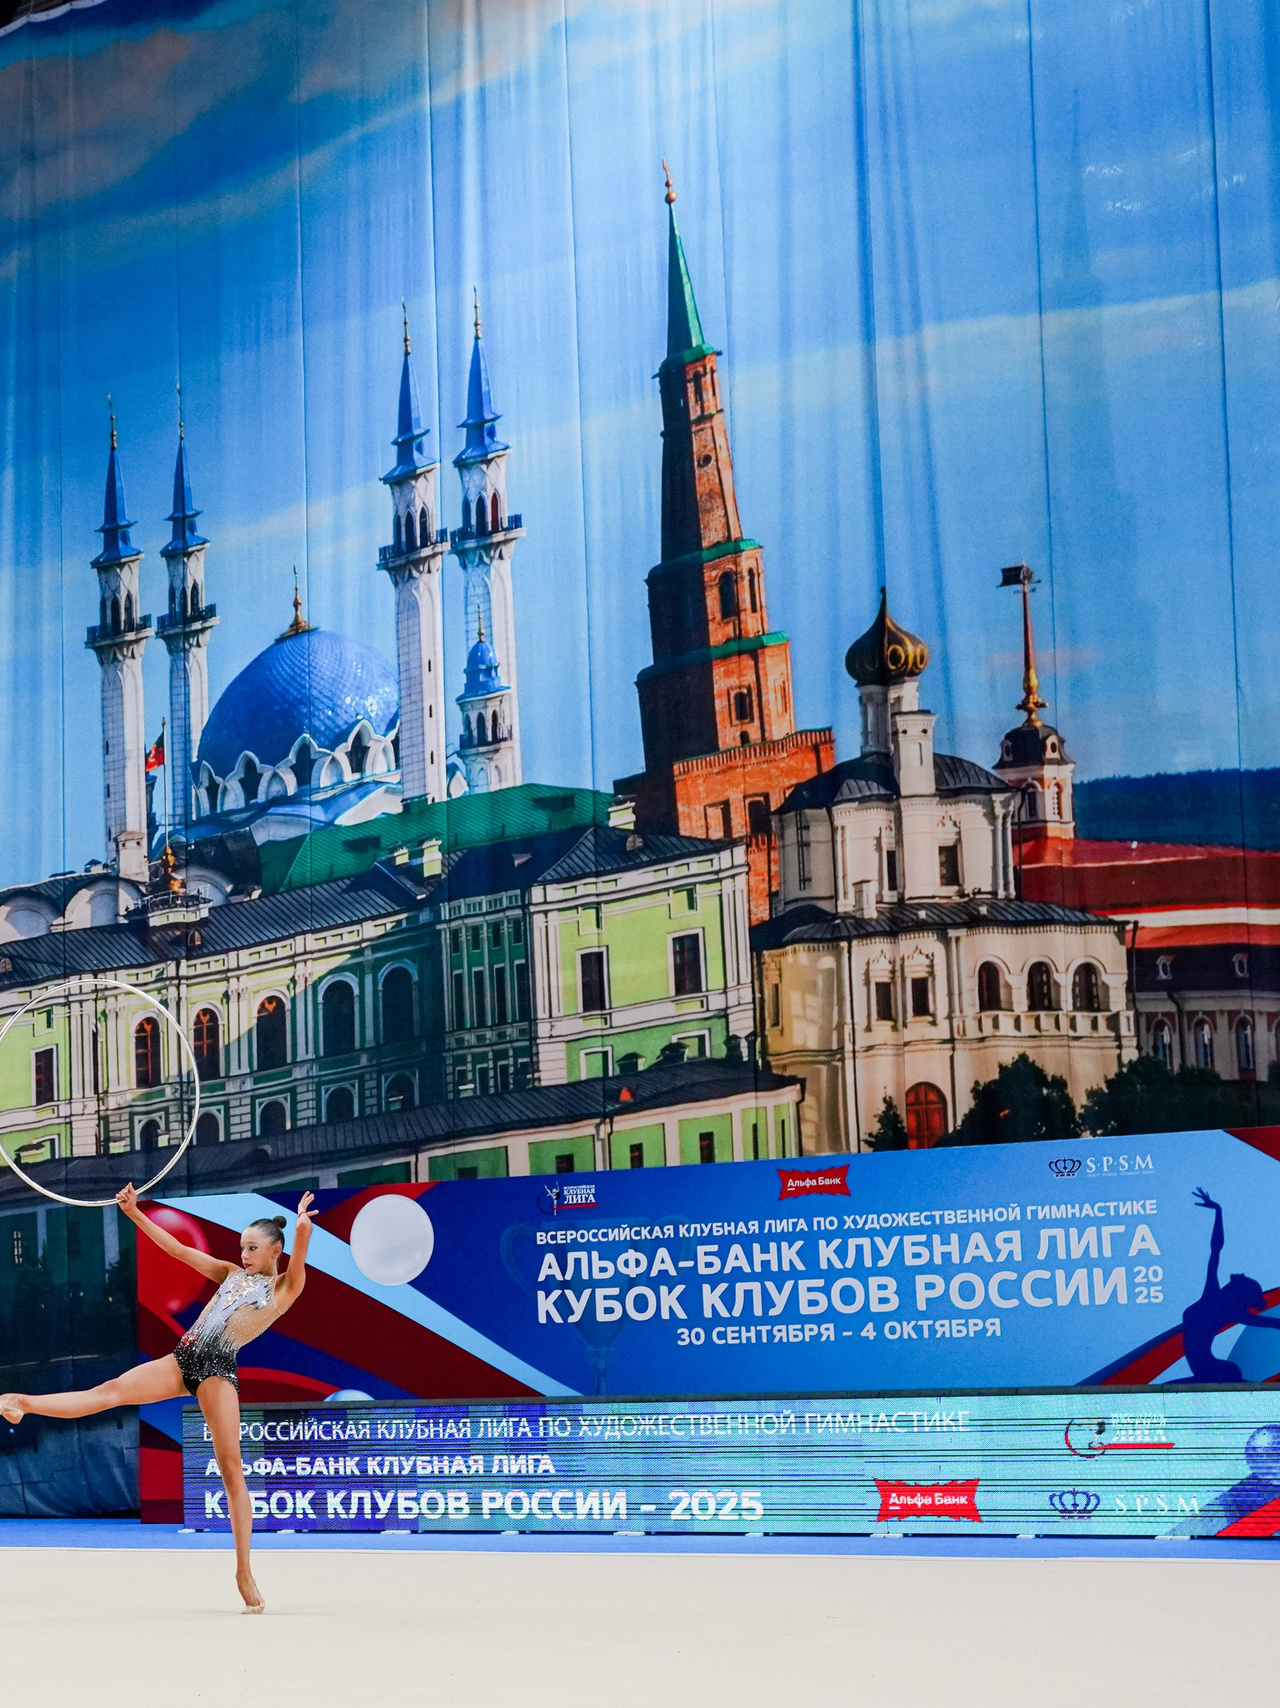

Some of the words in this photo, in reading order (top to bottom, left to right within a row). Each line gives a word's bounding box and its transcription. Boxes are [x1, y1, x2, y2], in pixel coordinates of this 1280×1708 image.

[563, 1188, 596, 1196] КЛУБНАЯ
[787, 1178, 817, 1190] Альфа
[818, 1176, 841, 1186] Банк
[563, 1193, 596, 1204] ЛИГА
[536, 1224, 674, 1245] ВСЕРОССИЙСКАЯ
[678, 1219, 759, 1238] КЛУБНАЯ
[763, 1217, 809, 1234] ЛИГА
[812, 1215, 839, 1231] ПО
[842, 1203, 1021, 1230] ХУДОЖЕСТВЕННОЙ
[1026, 1199, 1158, 1220] ГИМНАСТИКЕ
[537, 1242, 806, 1282] АЛЬФА-БАНК
[819, 1229, 1023, 1270] КЛУБНАЯ
[1036, 1224, 1161, 1261] ЛИГА
[1133, 1265, 1164, 1283] 20
[537, 1284, 688, 1324] КУБОК
[702, 1275, 900, 1319] КЛУБОВ
[915, 1266, 1128, 1312] РОССИИ
[1134, 1286, 1164, 1304] 25
[677, 1327, 706, 1346] 30
[711, 1323, 835, 1345] СЕНТЯБРЯ
[860, 1322, 877, 1340] 4
[883, 1317, 1001, 1340] ОКТЯБРЯ
[203, 1418, 370, 1441] ВРОССИЙСКАЯ
[377, 1419, 470, 1439] КЛУБНАЯ
[478, 1417, 532, 1438] ЛИГА
[539, 1416, 571, 1437] ПО
[578, 1409, 796, 1440] ХУДОЖЕСТВЕННОЙ
[805, 1411, 971, 1434] ГИМНАСТИКЕ
[205, 1457, 360, 1476] АЬФА-БАНК
[367, 1456, 484, 1476] КЛУБНАЯ
[492, 1454, 556, 1474] ЛИГА
[204, 1490, 317, 1519] КБОК
[326, 1489, 470, 1519] КЛУБОВ
[481, 1489, 628, 1519] РОССИИ
[669, 1489, 764, 1520] 2025
[889, 1492, 932, 1509] Альфа
[934, 1492, 968, 1504] Банк
